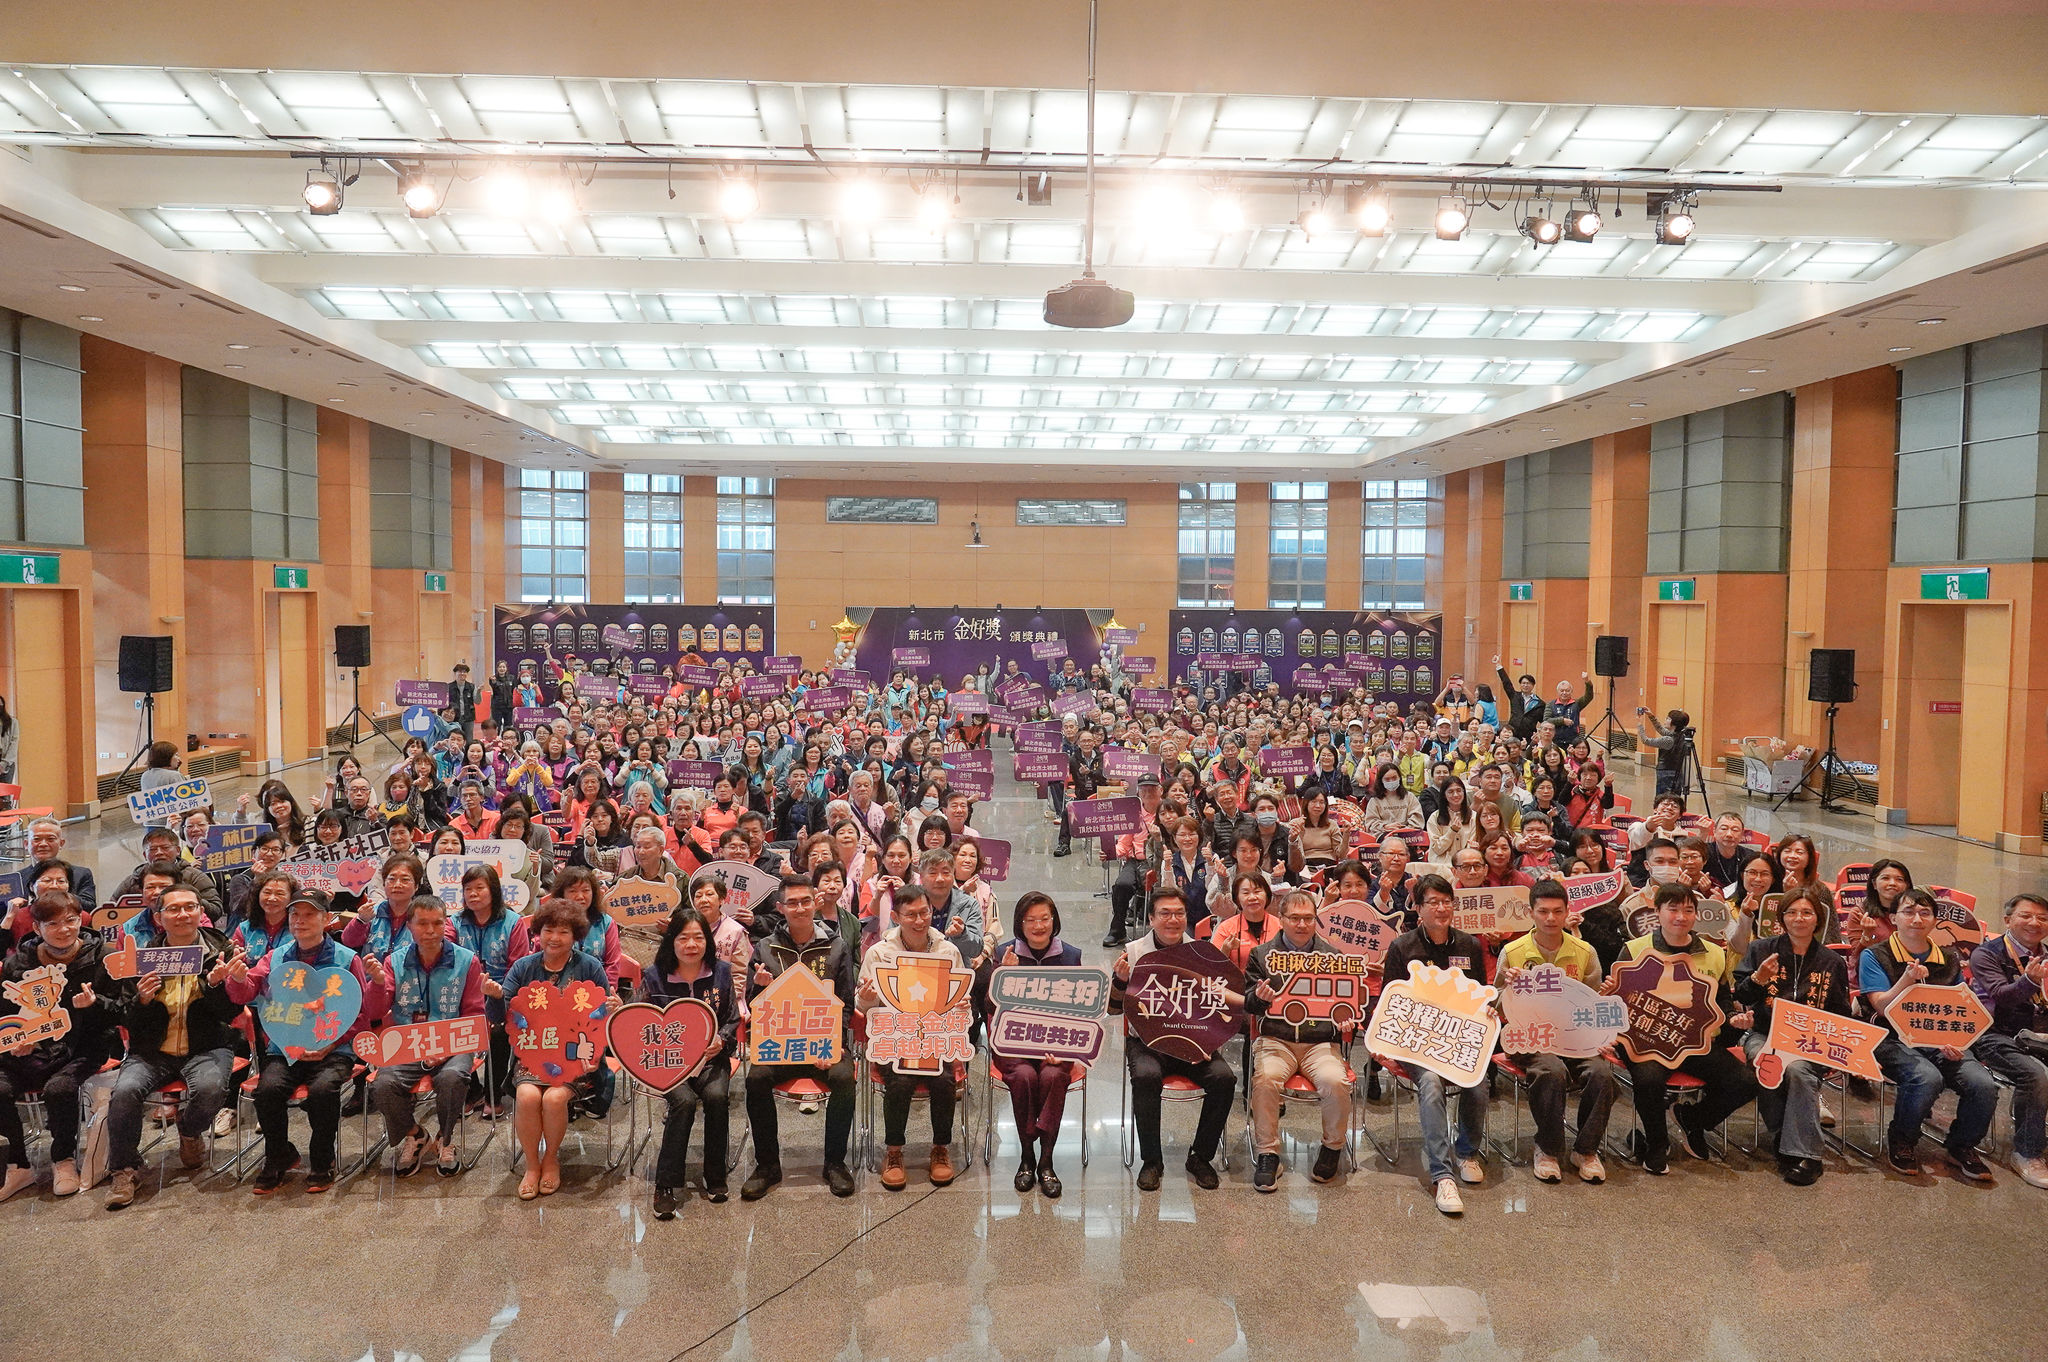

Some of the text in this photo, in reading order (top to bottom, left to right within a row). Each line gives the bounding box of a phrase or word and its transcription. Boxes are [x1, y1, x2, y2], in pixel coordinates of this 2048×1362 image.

[908, 617, 1059, 643] 新北市 金好獎 頒獎典禮
[145, 799, 198, 818] 林口區公所
[1085, 814, 1127, 824] 新北市土城區
[222, 826, 258, 847] 林口
[281, 863, 339, 877] 幸福林口
[1568, 876, 1618, 901] 超級優秀
[142, 950, 183, 963] 我永和
[154, 962, 194, 974] 我驕傲
[1267, 952, 1367, 976] 相揪來社區
[1001, 974, 1100, 1006] 新北金好
[1512, 968, 1563, 995] 共生
[32, 984, 49, 1008] 永和
[1134, 973, 1233, 1022] 金好獎
[263, 1003, 304, 1025] 社區
[756, 998, 837, 1037] 社區
[871, 1010, 971, 1036] 勇奪金好
[1385, 994, 1488, 1049] 榮耀加冕
[1573, 1001, 1624, 1028] 共融
[1627, 990, 1695, 1031] 社區金好
[1, 1018, 65, 1045] 我們一起贏
[312, 1010, 342, 1042] 好
[516, 1026, 560, 1051] 社區
[639, 1020, 687, 1047] 我愛
[1003, 1019, 1091, 1049] 在地共好
[1180, 1023, 1209, 1031] Ceremony
[1504, 1022, 1557, 1049] 共好
[1909, 1017, 1976, 1034] 社區金幸福
[356, 1019, 480, 1059] 我 社區
[871, 1036, 973, 1059] 卓越非凡
[1375, 1018, 1480, 1073] 金好之選
[1794, 1033, 1853, 1066] 社區
[639, 1048, 686, 1071] 社區
